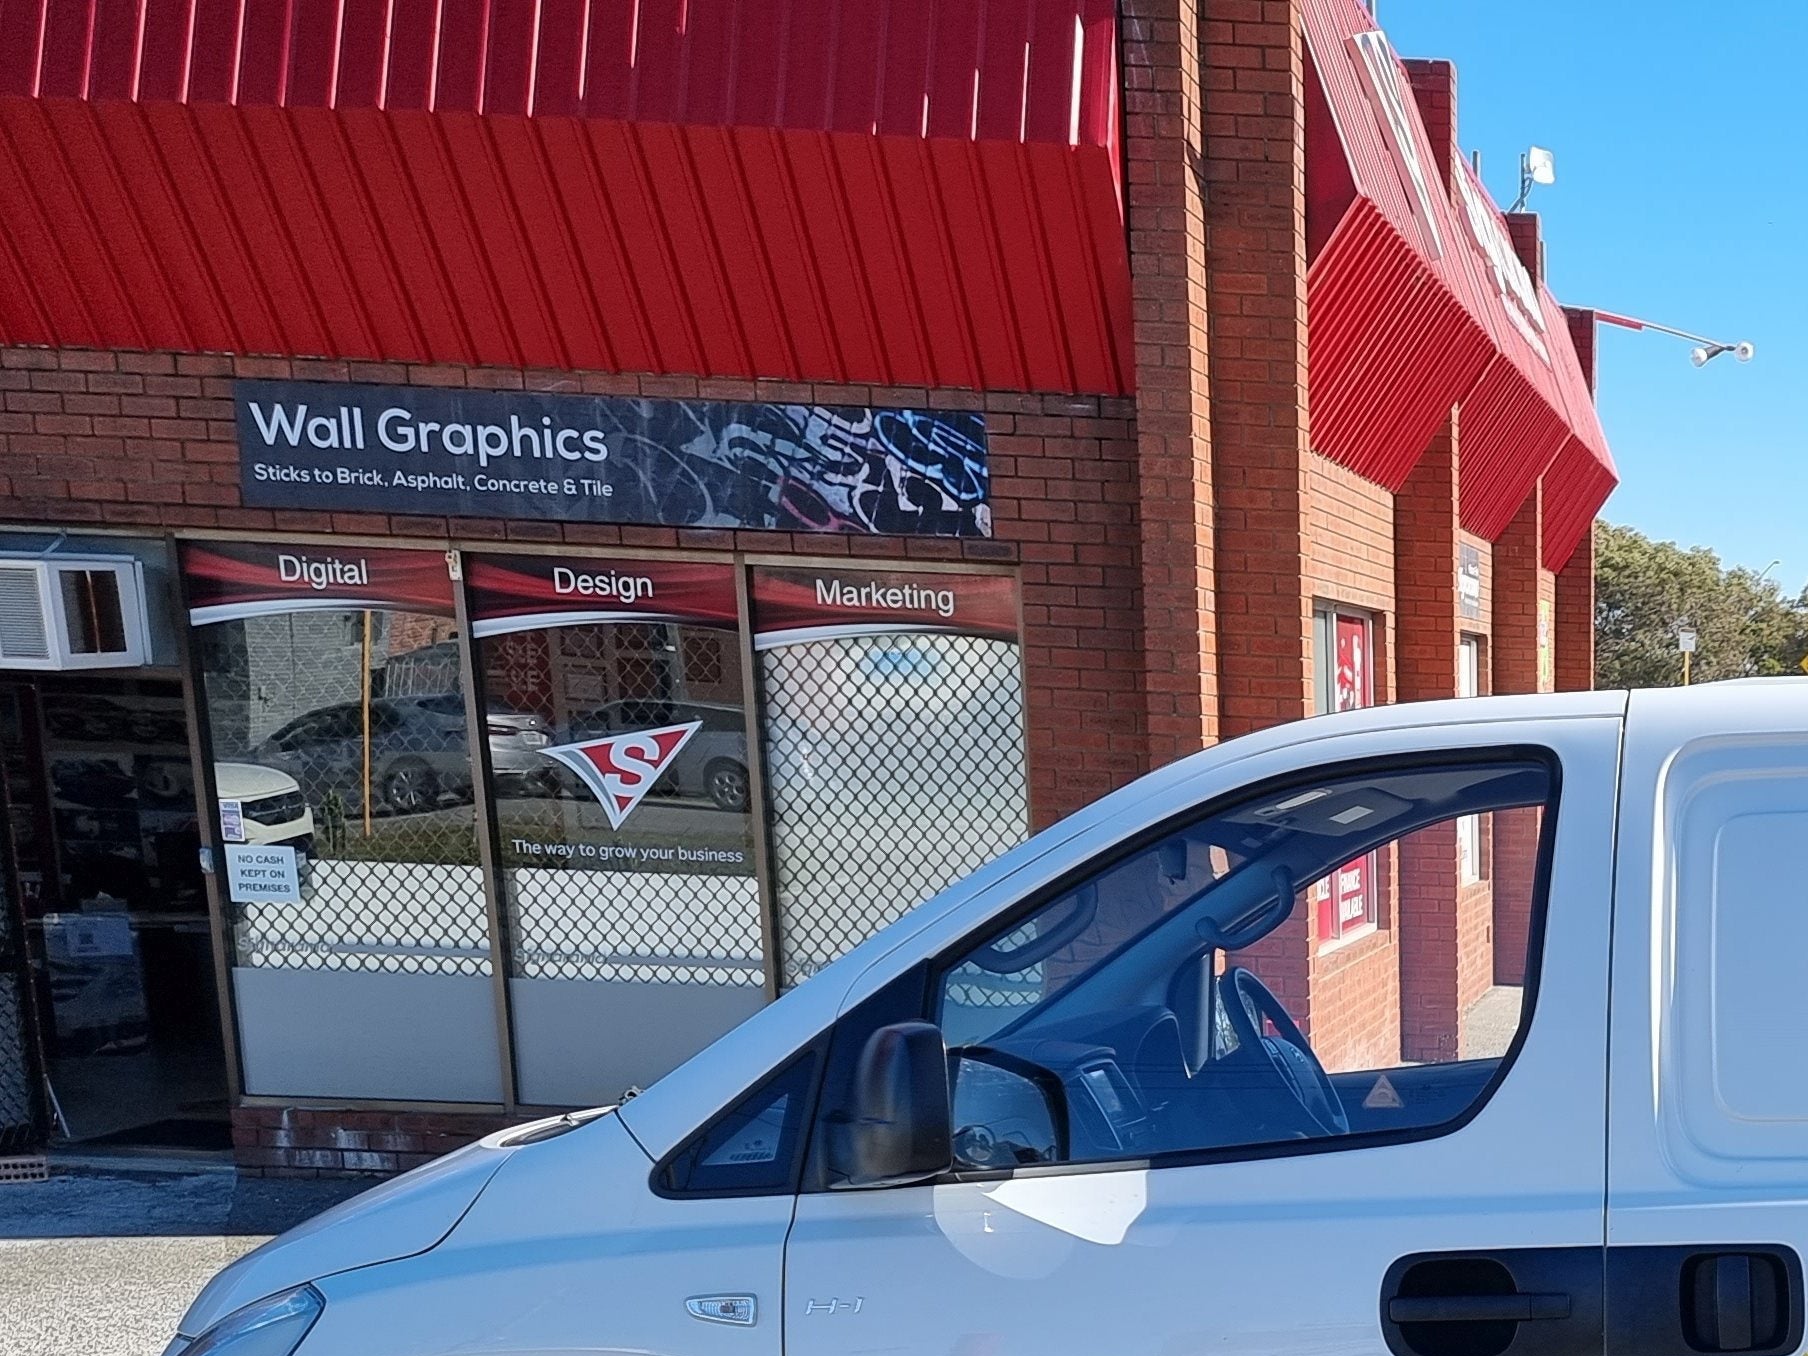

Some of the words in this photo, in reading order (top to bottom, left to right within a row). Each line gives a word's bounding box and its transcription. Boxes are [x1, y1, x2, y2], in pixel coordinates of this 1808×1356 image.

[248, 402, 365, 450] Wall
[377, 407, 610, 467] Graphics
[254, 463, 311, 484] Sticks
[313, 467, 333, 484] to
[336, 467, 389, 488] Brick,
[392, 471, 471, 492] Asphalt,
[474, 474, 559, 495] Concrete
[563, 478, 578, 496] &
[579, 478, 614, 498] Tile
[278, 554, 369, 591] Digital
[553, 566, 654, 604] Design
[815, 578, 955, 617] Marketing
[237, 855, 253, 864] NO
[256, 855, 285, 865] CASH
[512, 839, 541, 855] The
[544, 845, 574, 860] way
[578, 843, 597, 857] to
[599, 847, 636, 861] grow
[640, 847, 676, 862] your
[678, 845, 744, 863] business
[238, 883, 291, 893] PREMISES
[240, 869, 267, 879] KEPT
[269, 869, 286, 879] ON
